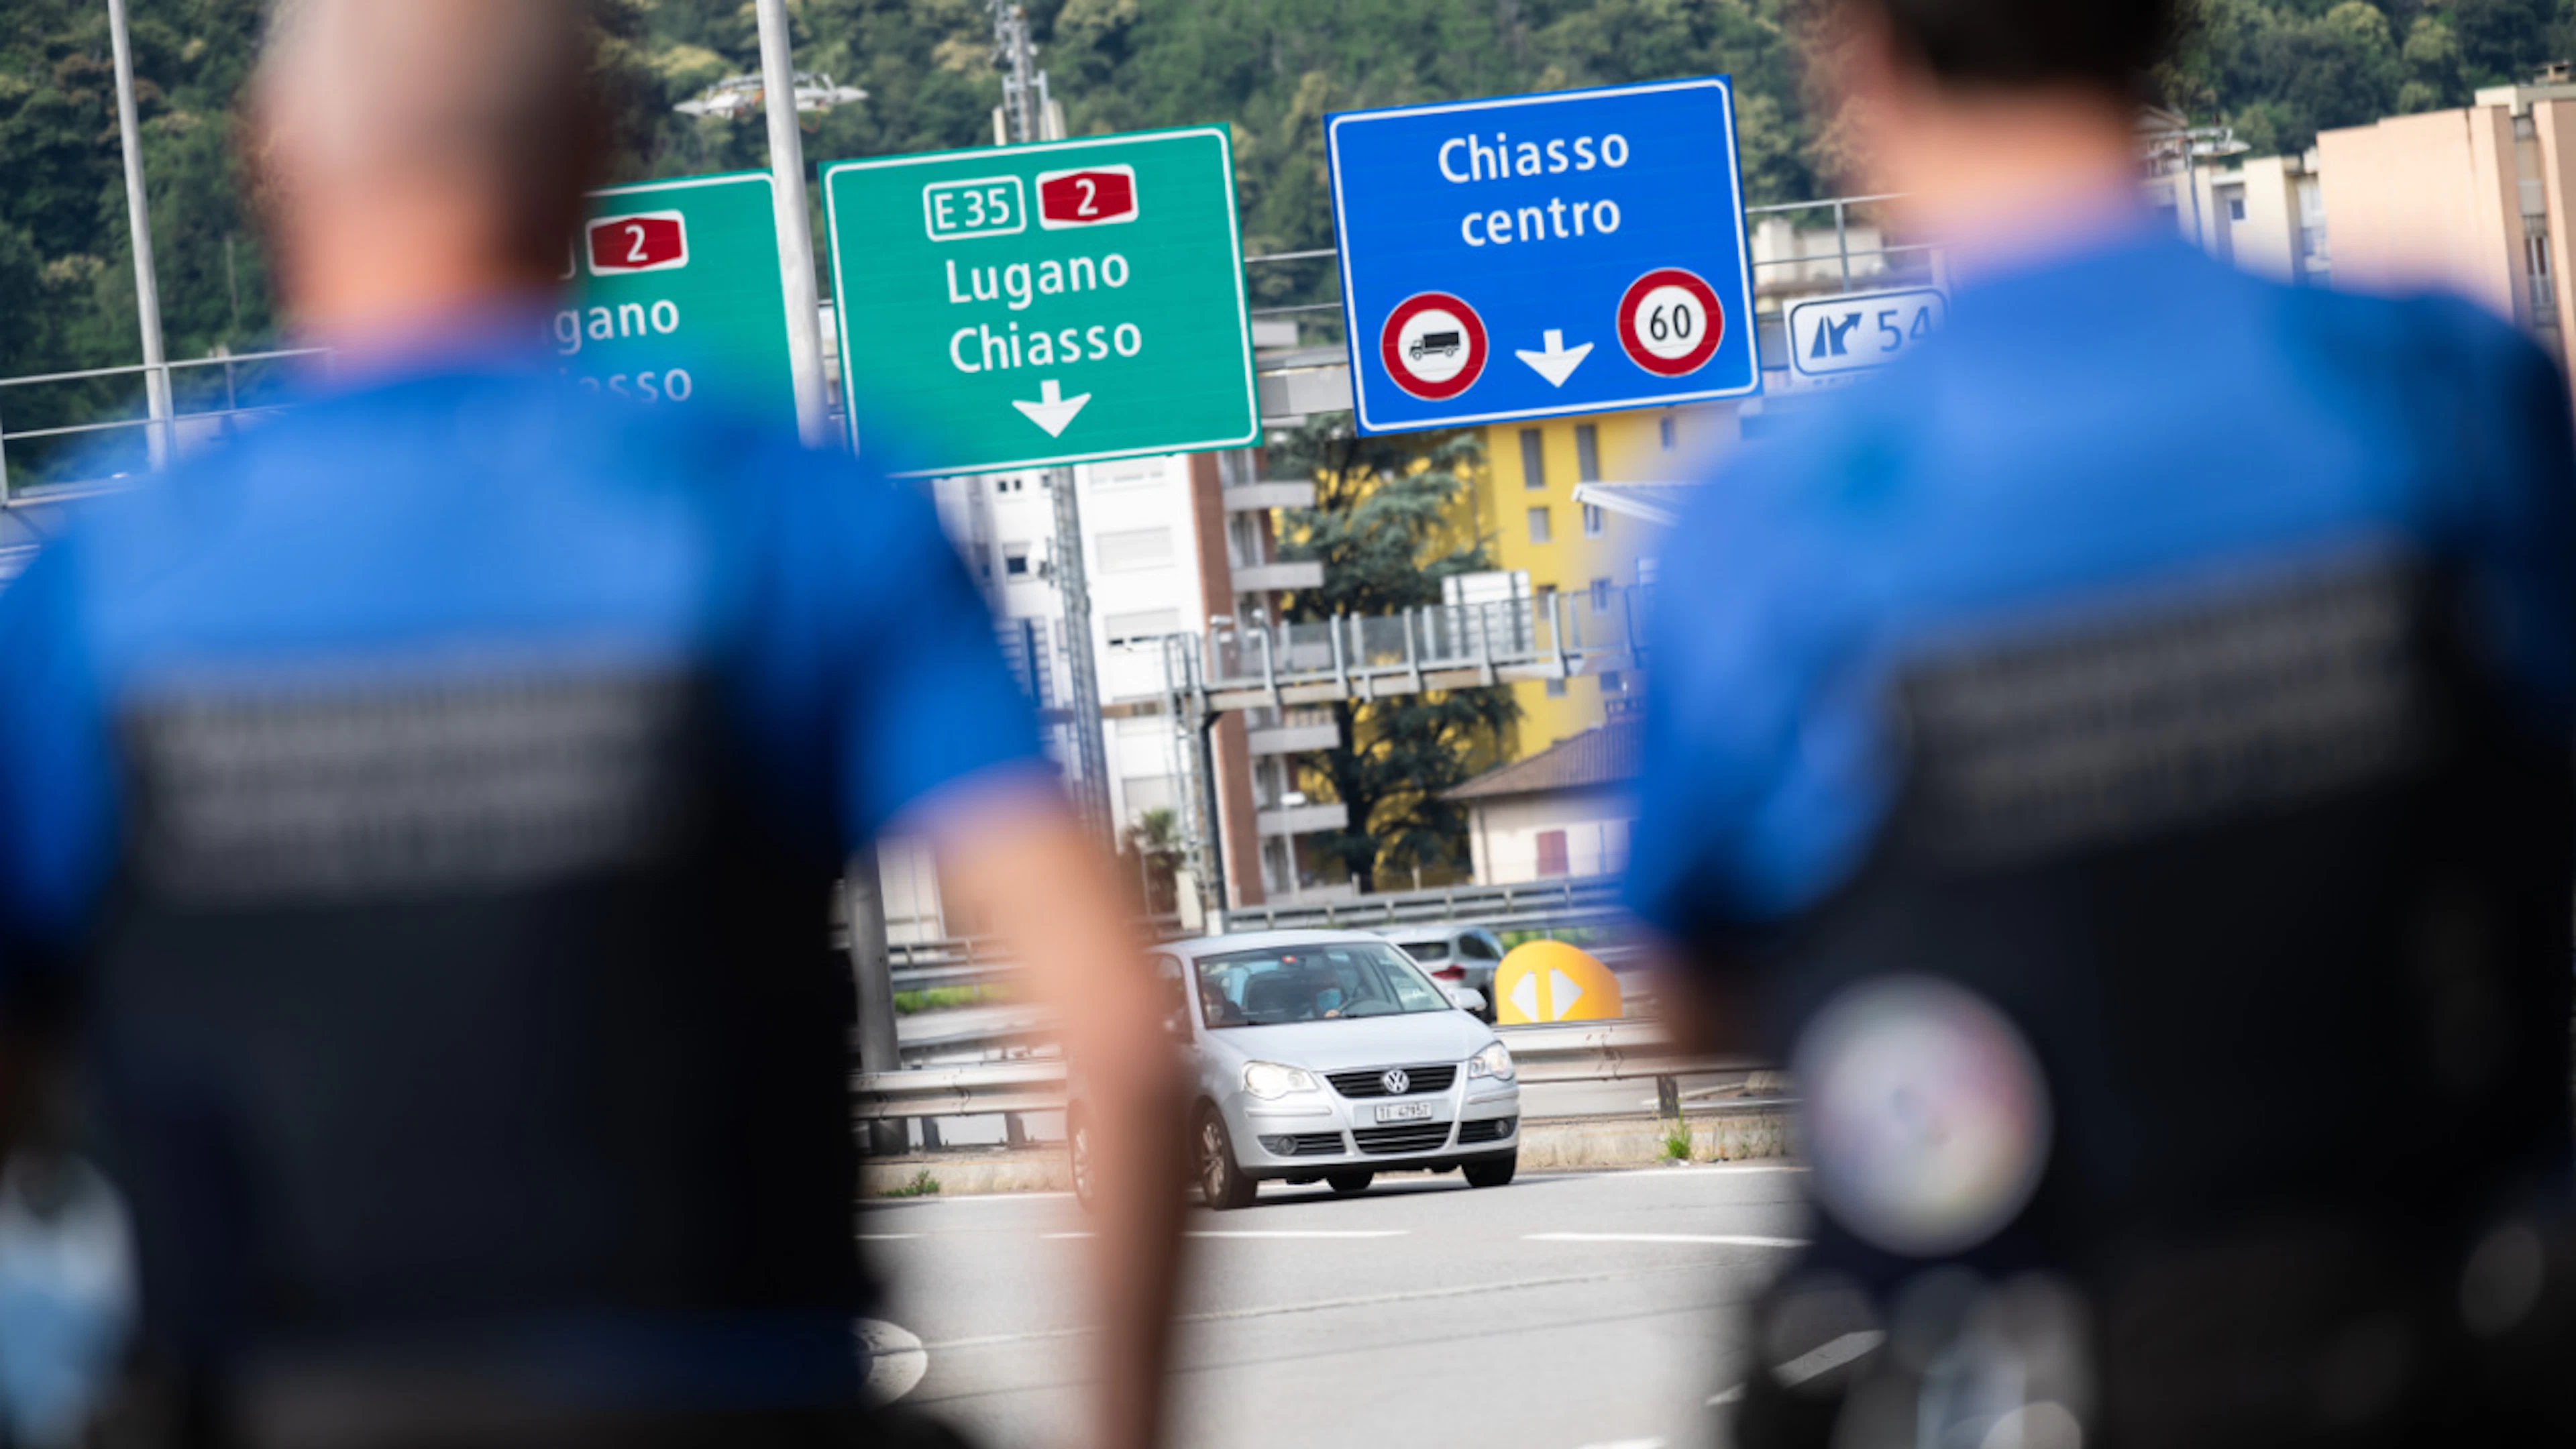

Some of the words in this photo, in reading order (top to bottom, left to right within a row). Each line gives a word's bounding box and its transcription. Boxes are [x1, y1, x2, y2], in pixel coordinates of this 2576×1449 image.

[1438, 132, 1629, 184] Chiasso
[1074, 178, 1099, 217] 2
[1461, 197, 1621, 247] centro
[625, 224, 648, 262] 2
[946, 254, 1130, 311] Lugano
[551, 299, 680, 355] gano
[1650, 303, 1692, 341] 60
[1876, 305, 1933, 354] 54
[949, 322, 1142, 373] Chiasso
